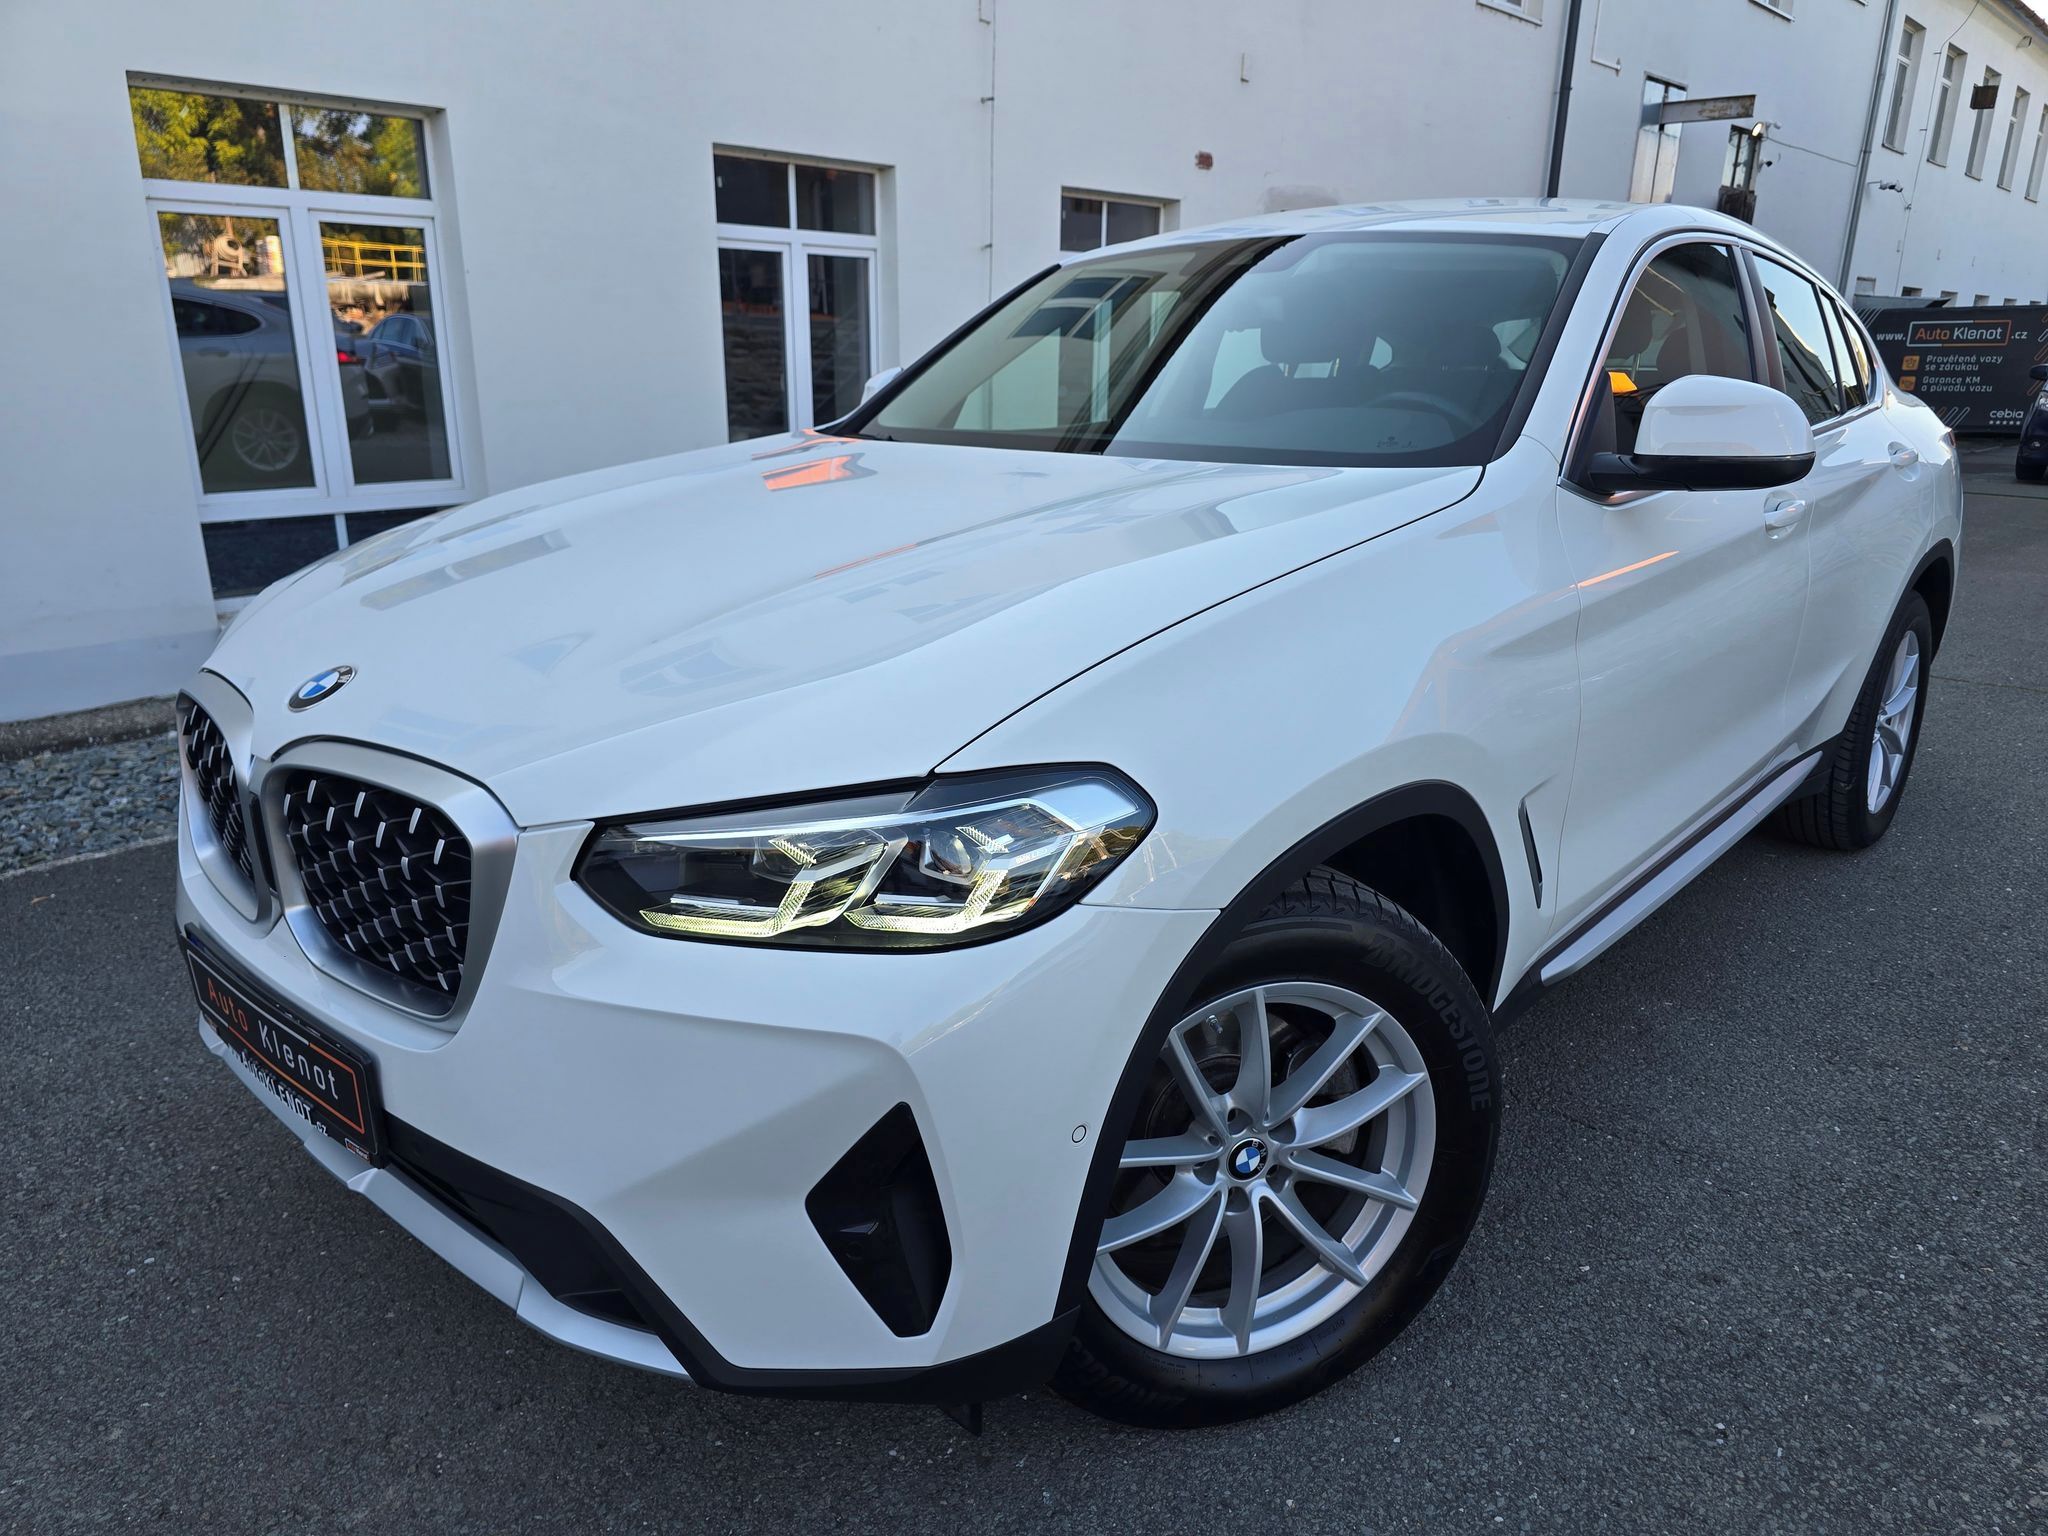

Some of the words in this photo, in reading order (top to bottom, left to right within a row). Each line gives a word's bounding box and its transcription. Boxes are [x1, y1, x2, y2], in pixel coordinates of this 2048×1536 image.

[1876, 332, 1906, 341] www.
[1915, 327, 1950, 340] Auto
[1953, 326, 2002, 340] Klenot
[1924, 363, 1936, 371] se
[1980, 356, 2003, 365] vozy
[1922, 376, 1962, 384] Garance
[1965, 376, 1981, 384] KM
[1989, 408, 2024, 419] cebia
[1360, 932, 1494, 1113] BRIDGESTONE
[207, 977, 249, 1032] Auto
[257, 1019, 339, 1100] Klenot
[1251, 1139, 1267, 1171] BMW
